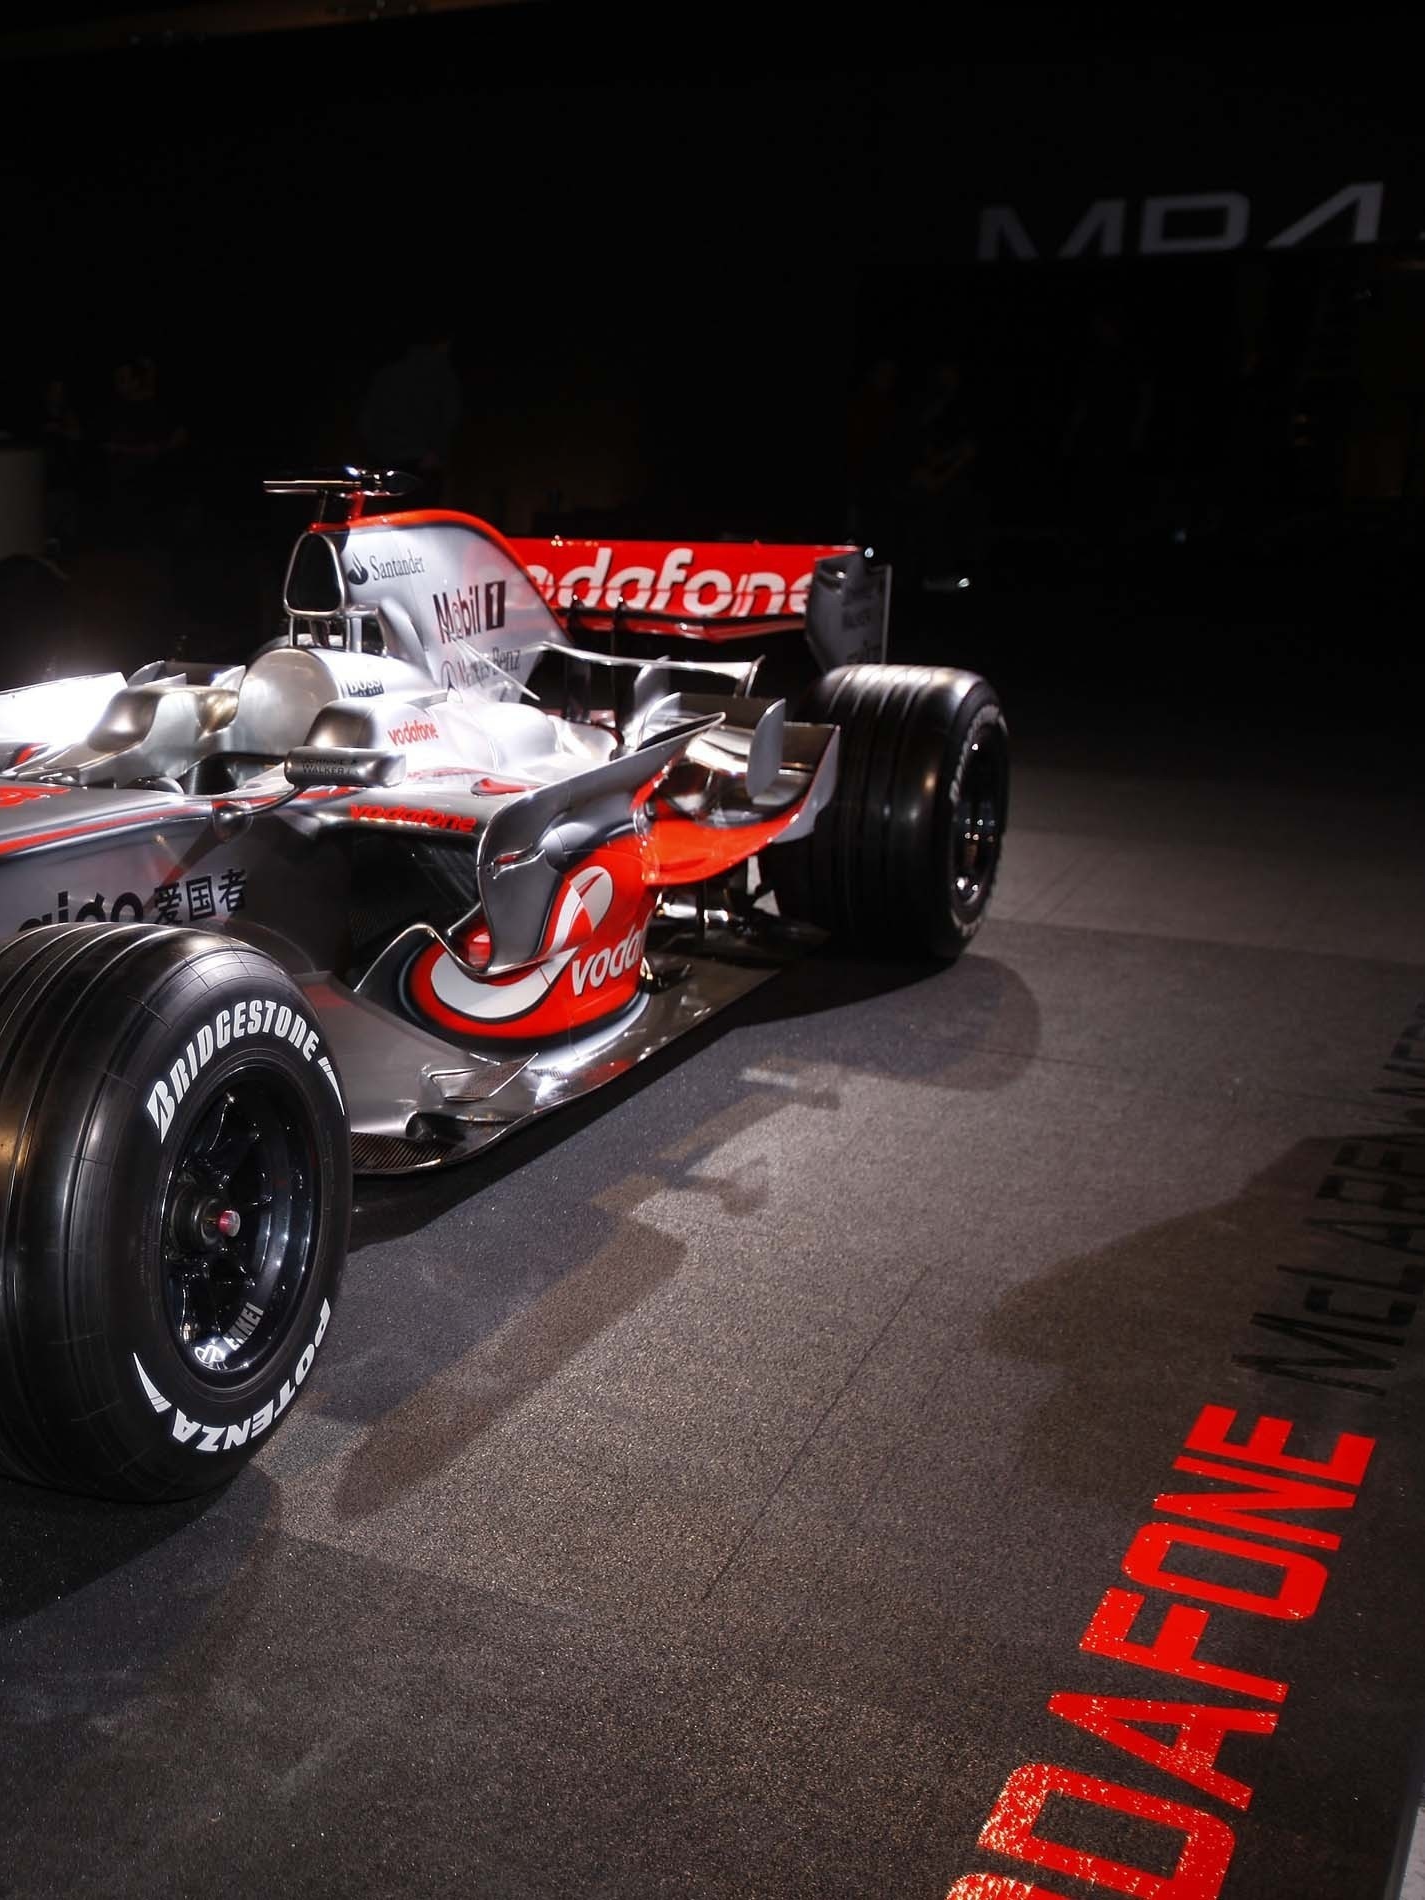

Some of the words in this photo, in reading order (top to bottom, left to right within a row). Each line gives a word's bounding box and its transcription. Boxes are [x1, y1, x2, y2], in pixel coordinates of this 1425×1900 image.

[369, 552, 425, 582] Santander
[432, 584, 482, 645] Mobil
[486, 582, 504, 629] 1
[387, 719, 440, 746] vodafone
[349, 802, 478, 833] vodafone
[153, 867, 248, 926] 爱国者
[146, 999, 320, 1144] BRIDGESTONE
[223, 1301, 265, 1351] ENKEI
[174, 1297, 332, 1452] POTENZA
